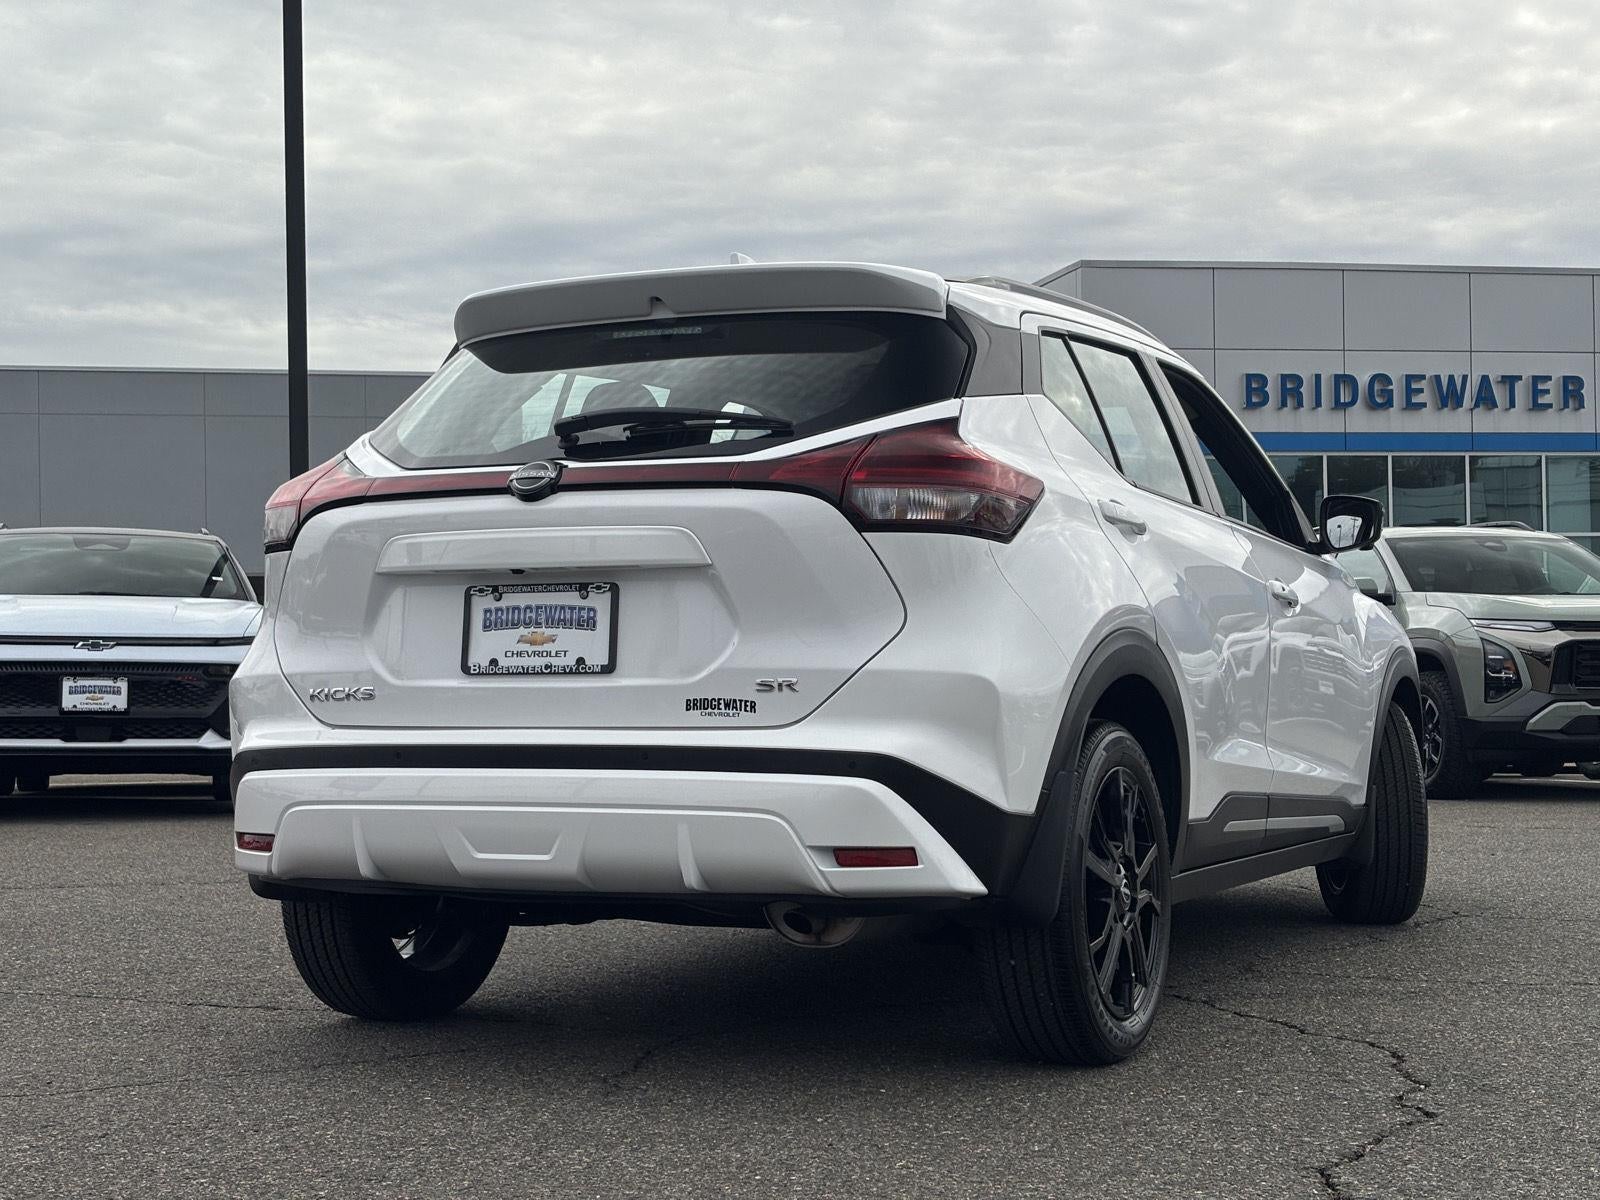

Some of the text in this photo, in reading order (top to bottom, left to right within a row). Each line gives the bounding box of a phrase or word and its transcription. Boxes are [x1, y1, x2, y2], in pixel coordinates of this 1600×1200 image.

[1243, 372, 1586, 410] BRIDGEWATER
[511, 470, 556, 479] NISSAN
[482, 604, 599, 632] BRIDGEWATER
[504, 650, 569, 658] CHEVROLET
[68, 684, 122, 696] BRIDGEWATER
[755, 677, 799, 693] SR
[309, 686, 377, 703] KICKS
[685, 697, 757, 713] BRIDGEWATER
